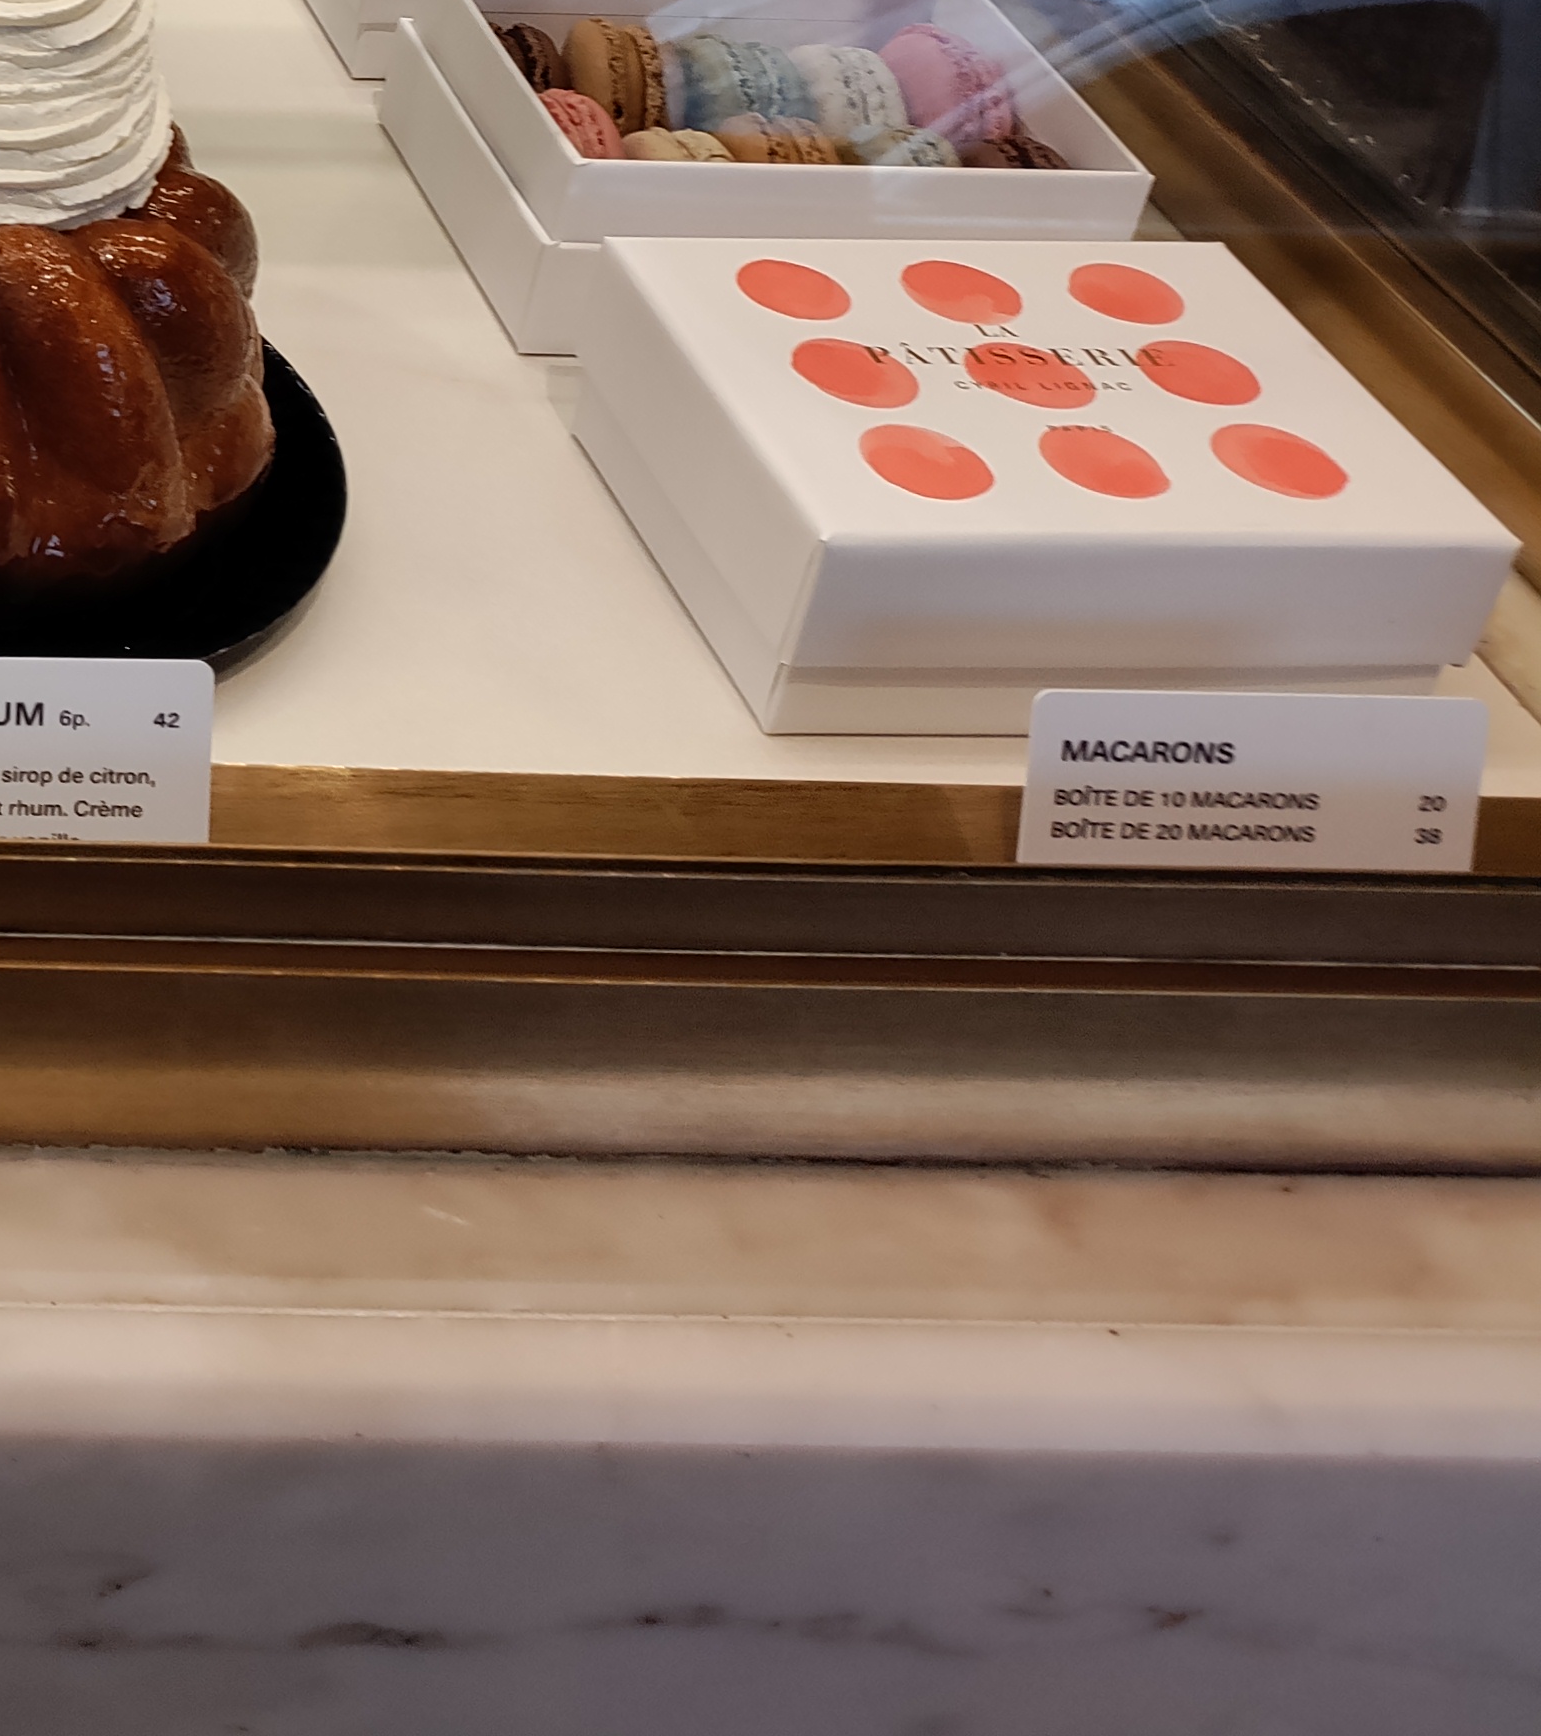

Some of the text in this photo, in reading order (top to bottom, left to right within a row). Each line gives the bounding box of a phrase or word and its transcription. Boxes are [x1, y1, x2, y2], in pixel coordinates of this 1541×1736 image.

[864, 342, 1176, 367] PÂTISSERIE
[60, 710, 89, 730] 6p.
[154, 713, 179, 728] 42
[1062, 740, 1234, 764] MACARONS
[2, 767, 52, 786] sirop
[58, 768, 84, 783] de
[90, 768, 155, 787] citron,
[9, 800, 68, 816] rhum.
[74, 800, 142, 817] Crème
[1054, 786, 1446, 812] BOÎTE DE 10 MACARONS 20
[1051, 818, 1442, 844] BOÎTE DE 20 MACARONS 38
